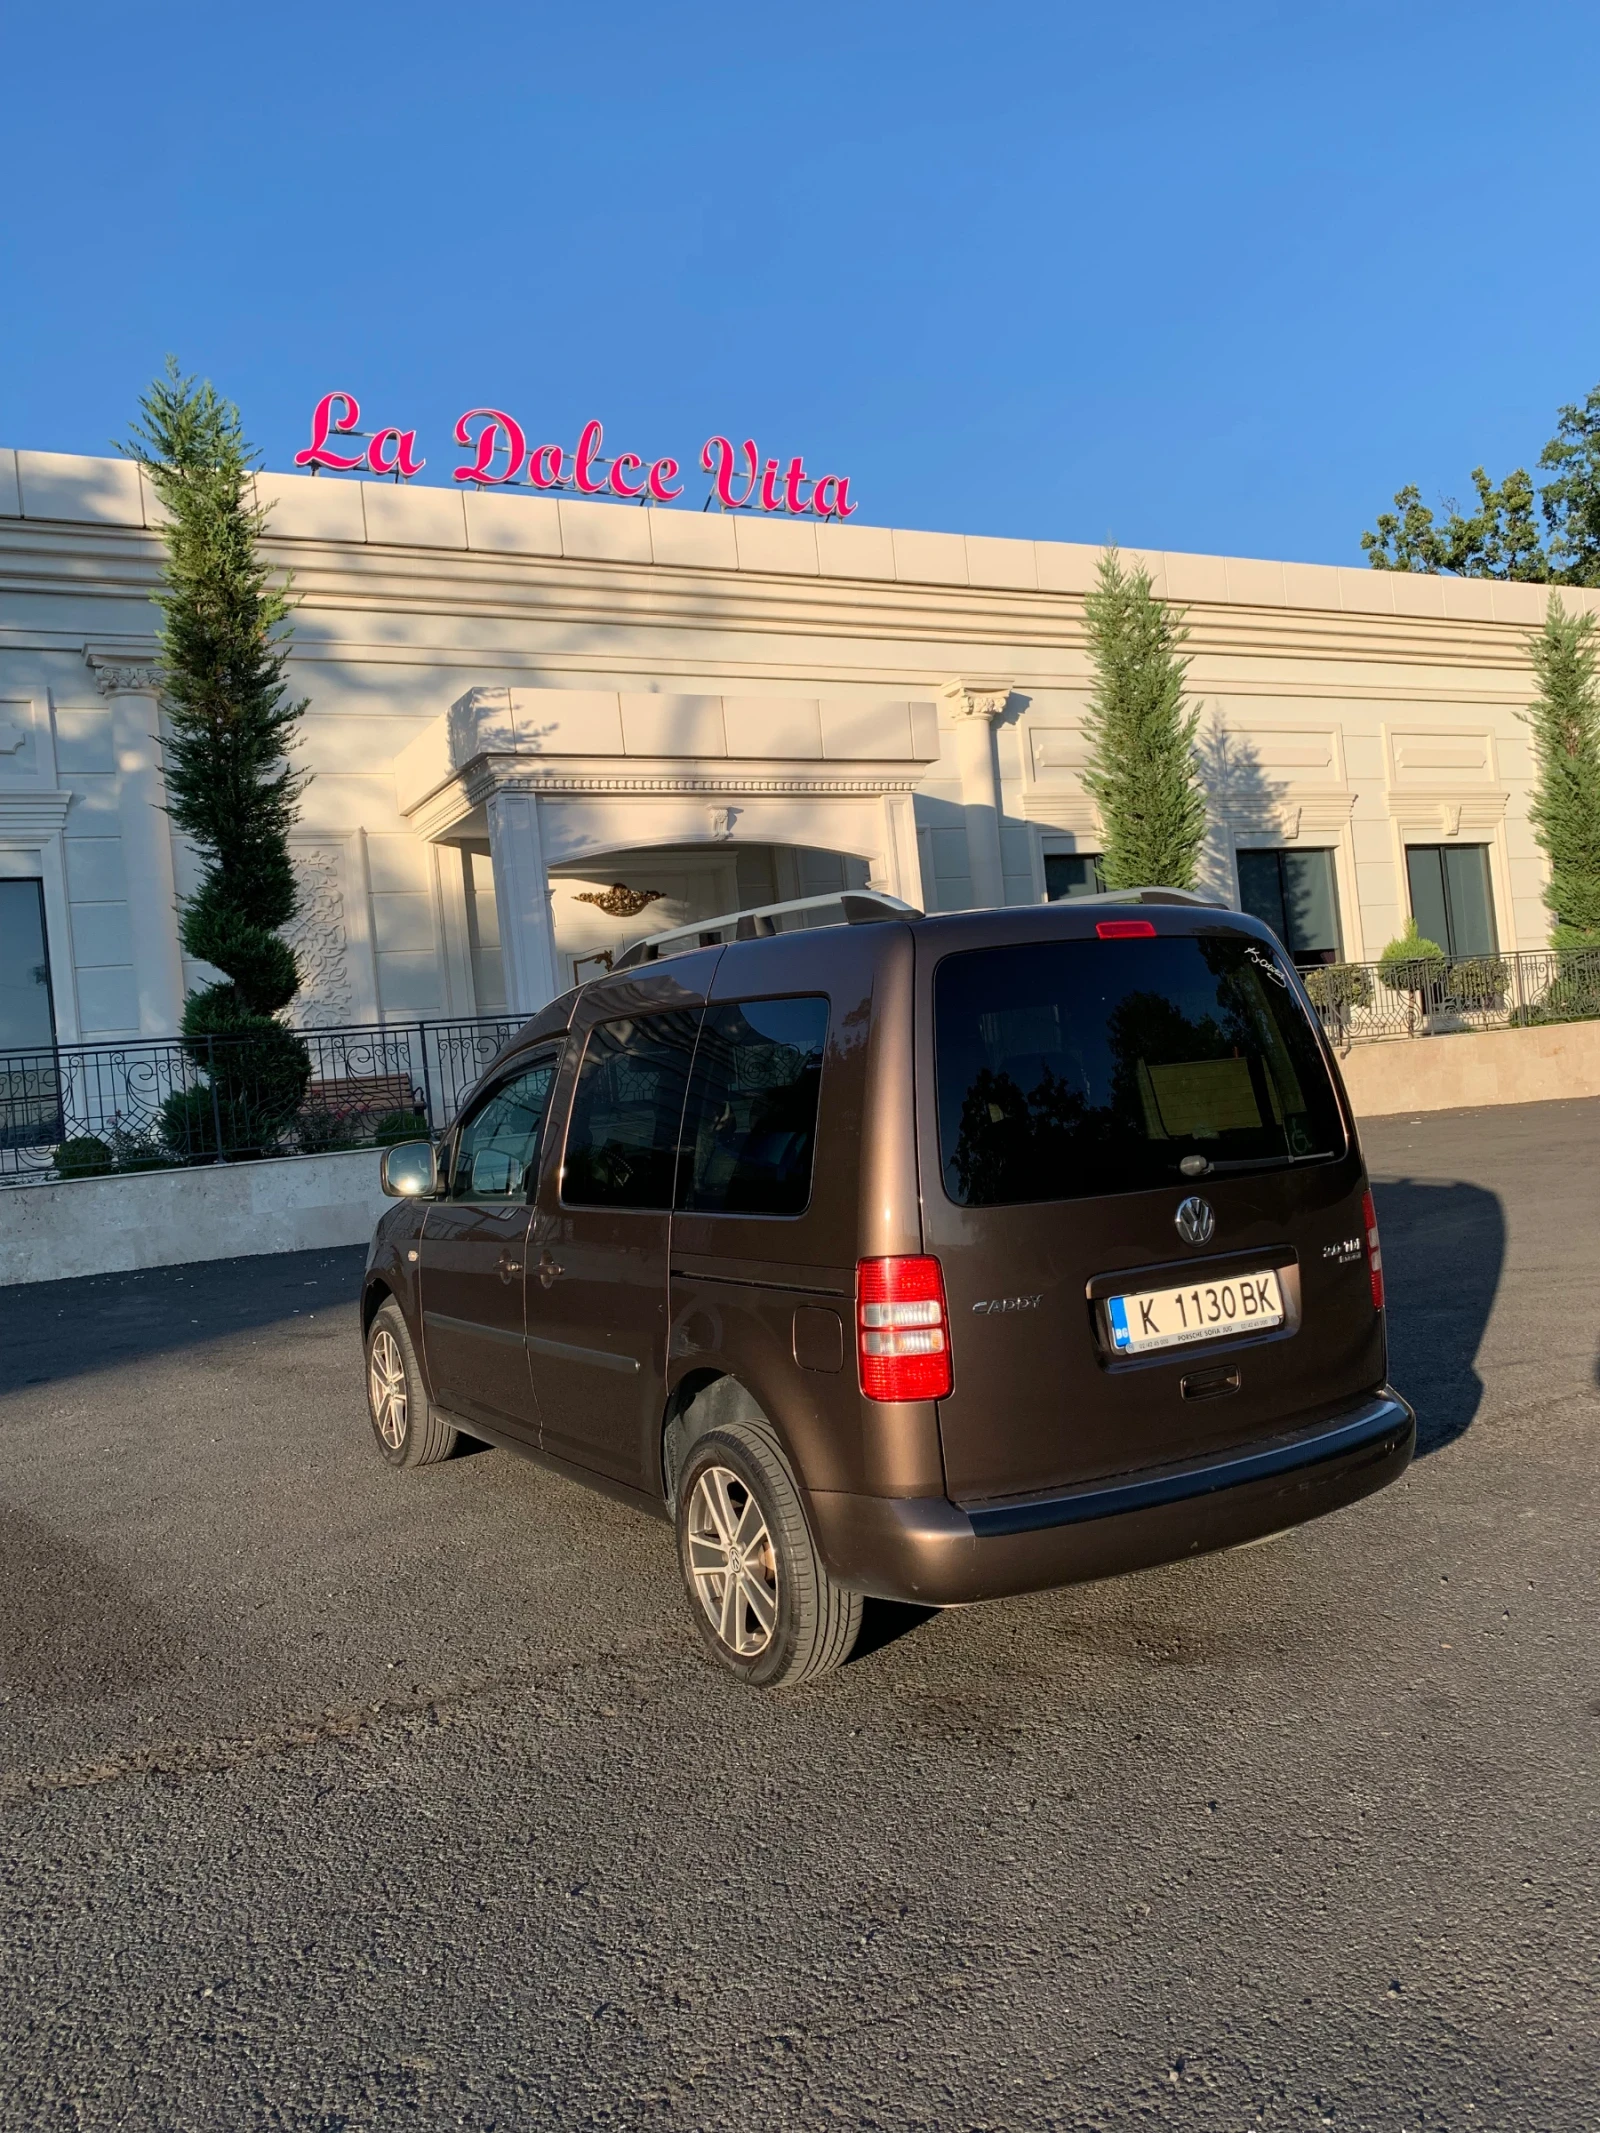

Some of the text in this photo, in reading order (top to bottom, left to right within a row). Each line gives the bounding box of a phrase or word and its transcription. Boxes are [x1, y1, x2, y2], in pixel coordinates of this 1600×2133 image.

[294, 391, 858, 517] La Dolce Vita
[972, 1294, 1044, 1314] CADDY
[1139, 1278, 1276, 1335] K 1130 BK
[1115, 1327, 1129, 1340] BG
[1177, 1330, 1203, 1342] PORSCHE
[1204, 1328, 1221, 1337] SOFIA
